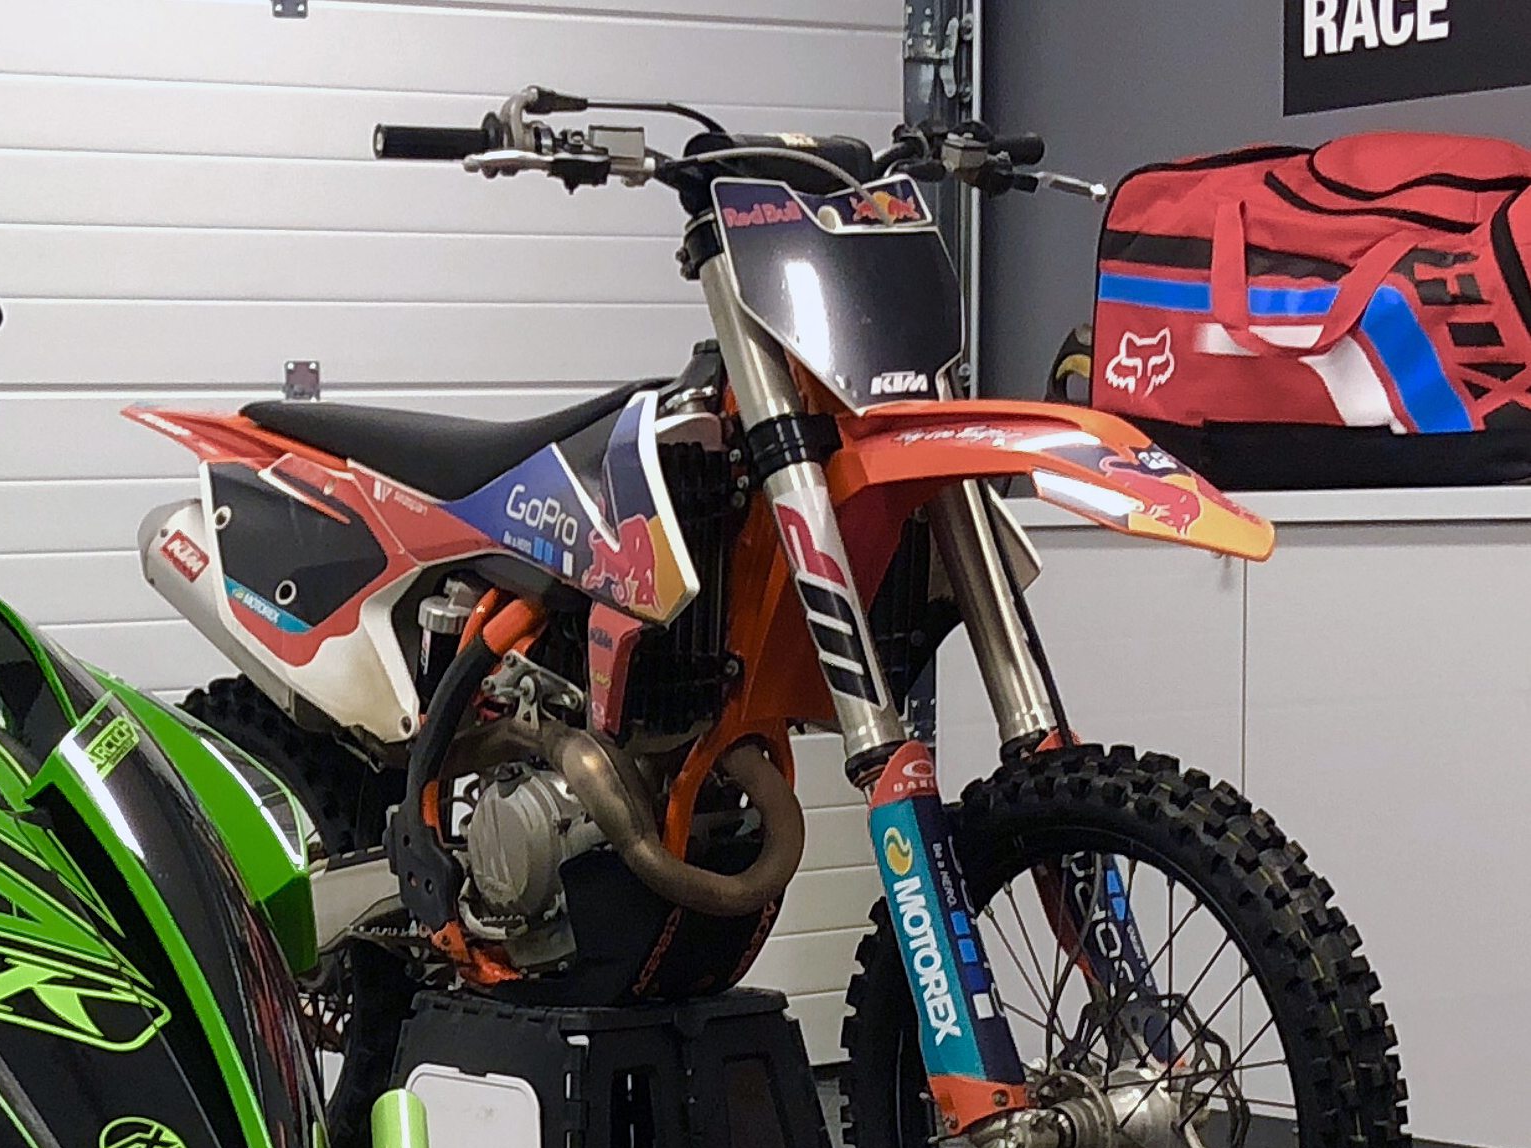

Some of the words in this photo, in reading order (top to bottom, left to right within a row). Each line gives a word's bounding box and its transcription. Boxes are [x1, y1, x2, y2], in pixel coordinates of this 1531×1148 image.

[1303, 0, 1449, 57] RACE
[870, 370, 929, 396] KTM
[505, 483, 579, 547] GoPro
[892, 874, 963, 1047] MOTOREX
